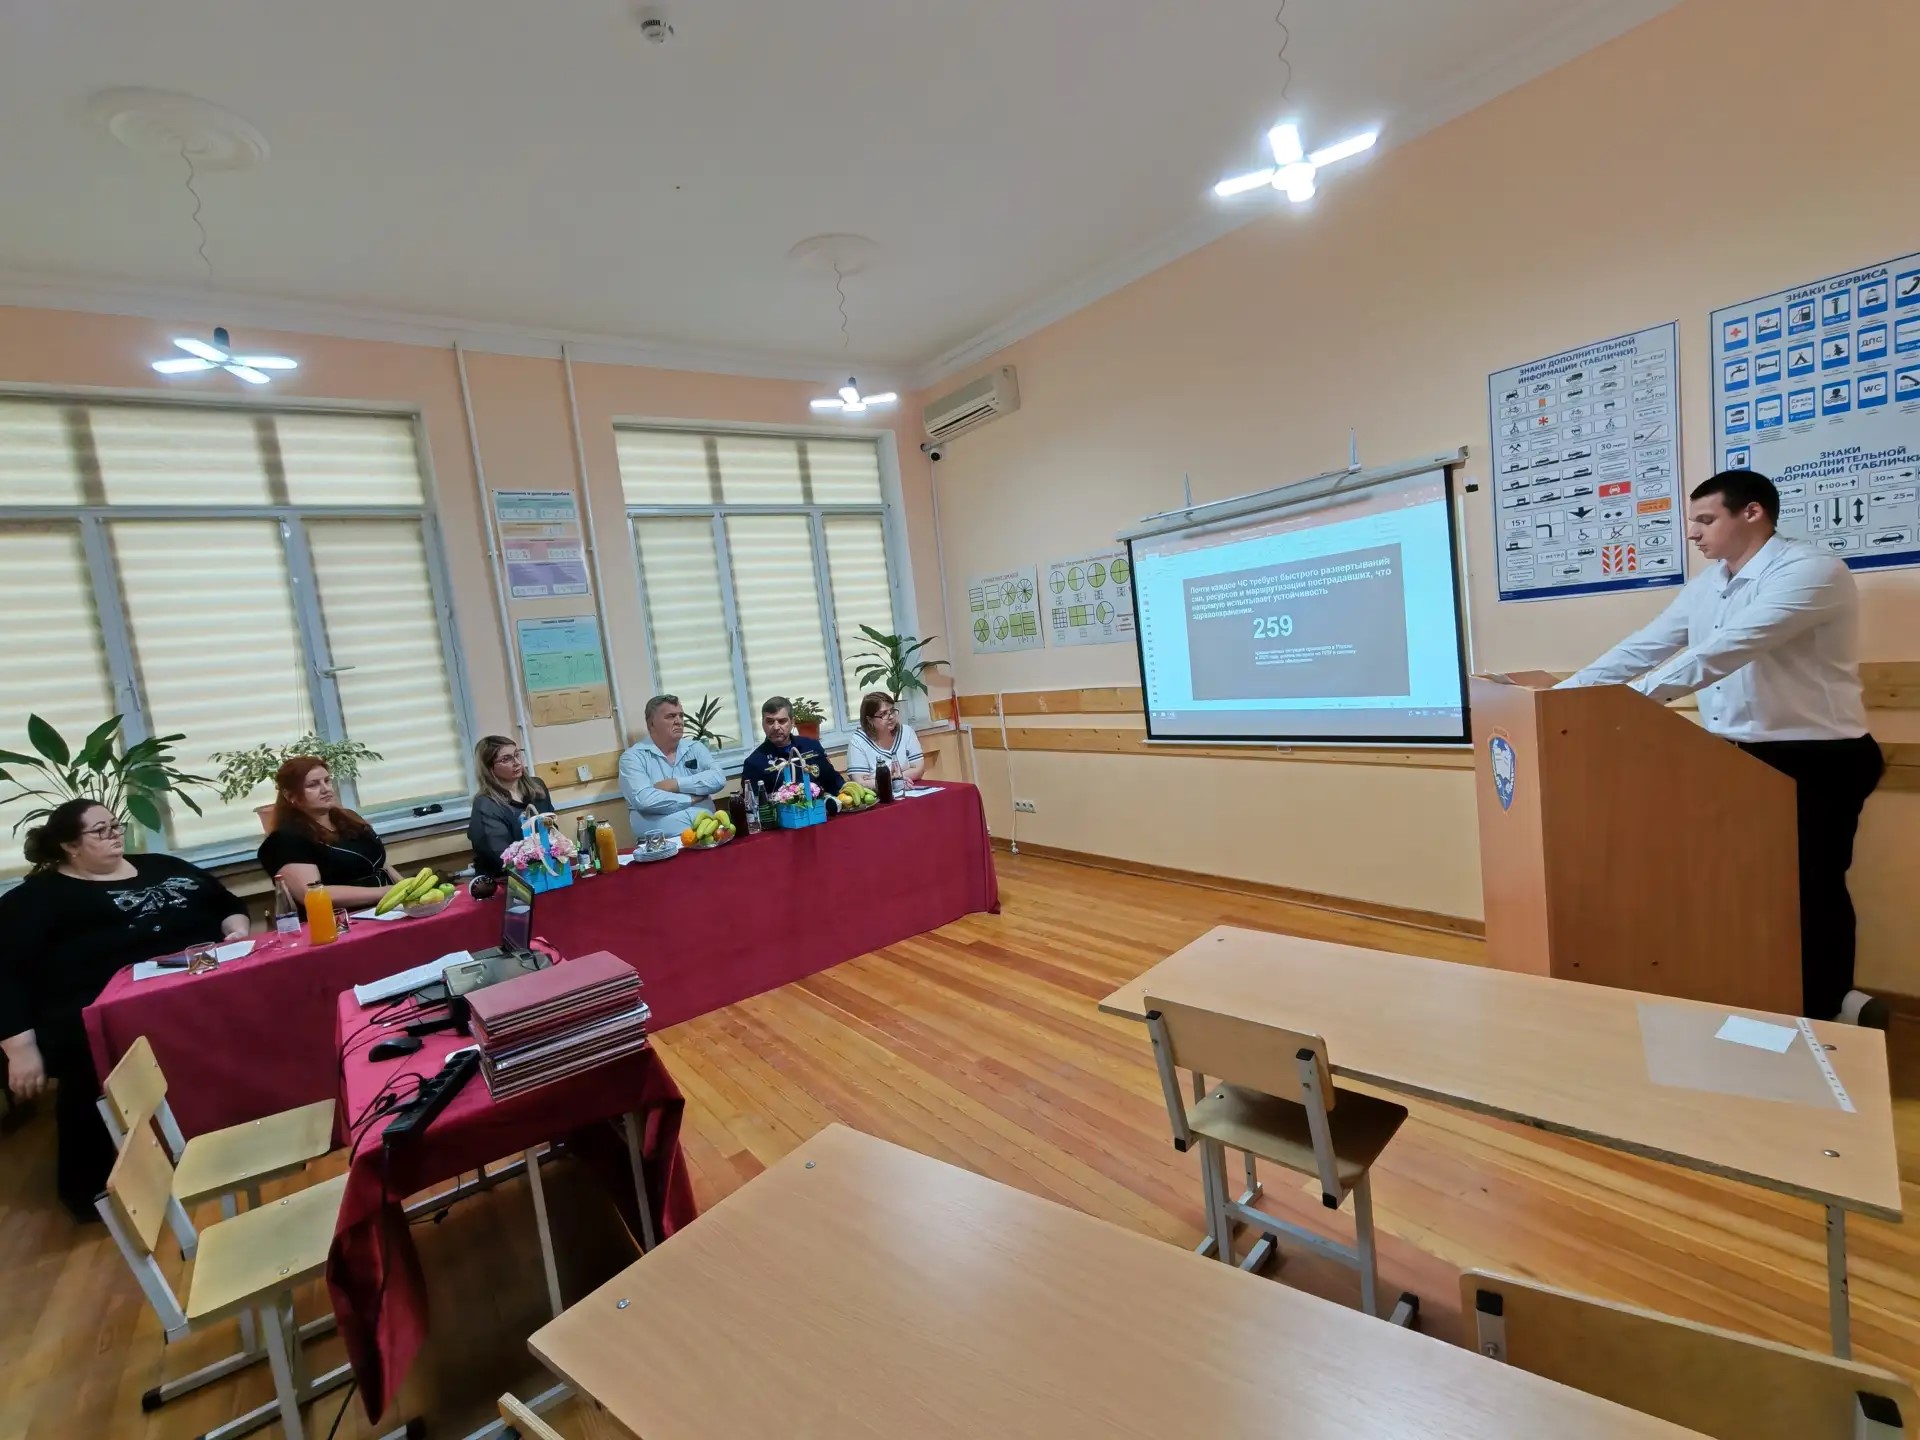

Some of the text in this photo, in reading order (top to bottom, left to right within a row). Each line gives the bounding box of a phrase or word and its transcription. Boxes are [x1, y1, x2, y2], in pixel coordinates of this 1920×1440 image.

[1785, 268, 1888, 303] ЗНАКИ СЕРВИСА
[1861, 336, 1883, 347] ДПС
[1518, 363, 1578, 385] ИНФОРМАЦИИ
[1579, 347, 1638, 370] (ТАБЛИЧКИ)
[1519, 364, 1547, 377] ЗНАКИ
[1548, 337, 1636, 369] ДОПОЛНИТЕЛЬНОЙ
[1863, 383, 1882, 393] WC
[1784, 445, 1907, 475] ДОПОЛНИТЕЛЬНОЙ
[1819, 446, 1861, 460] ЗНАКИ
[1771, 465, 1845, 484] ФОРМАЦИИ
[1652, 537, 1659, 545] 4
[1237, 579, 1248, 587] ЧС
[1249, 576, 1279, 588] требует
[1279, 569, 1319, 582] быстрого
[1320, 557, 1391, 577] развертывания
[1245, 581, 1306, 597] маршрутизации
[1307, 571, 1374, 588] пострадавших,
[1375, 568, 1392, 577] что
[1273, 587, 1329, 603] устойчивость
[1253, 614, 1293, 639] 259
